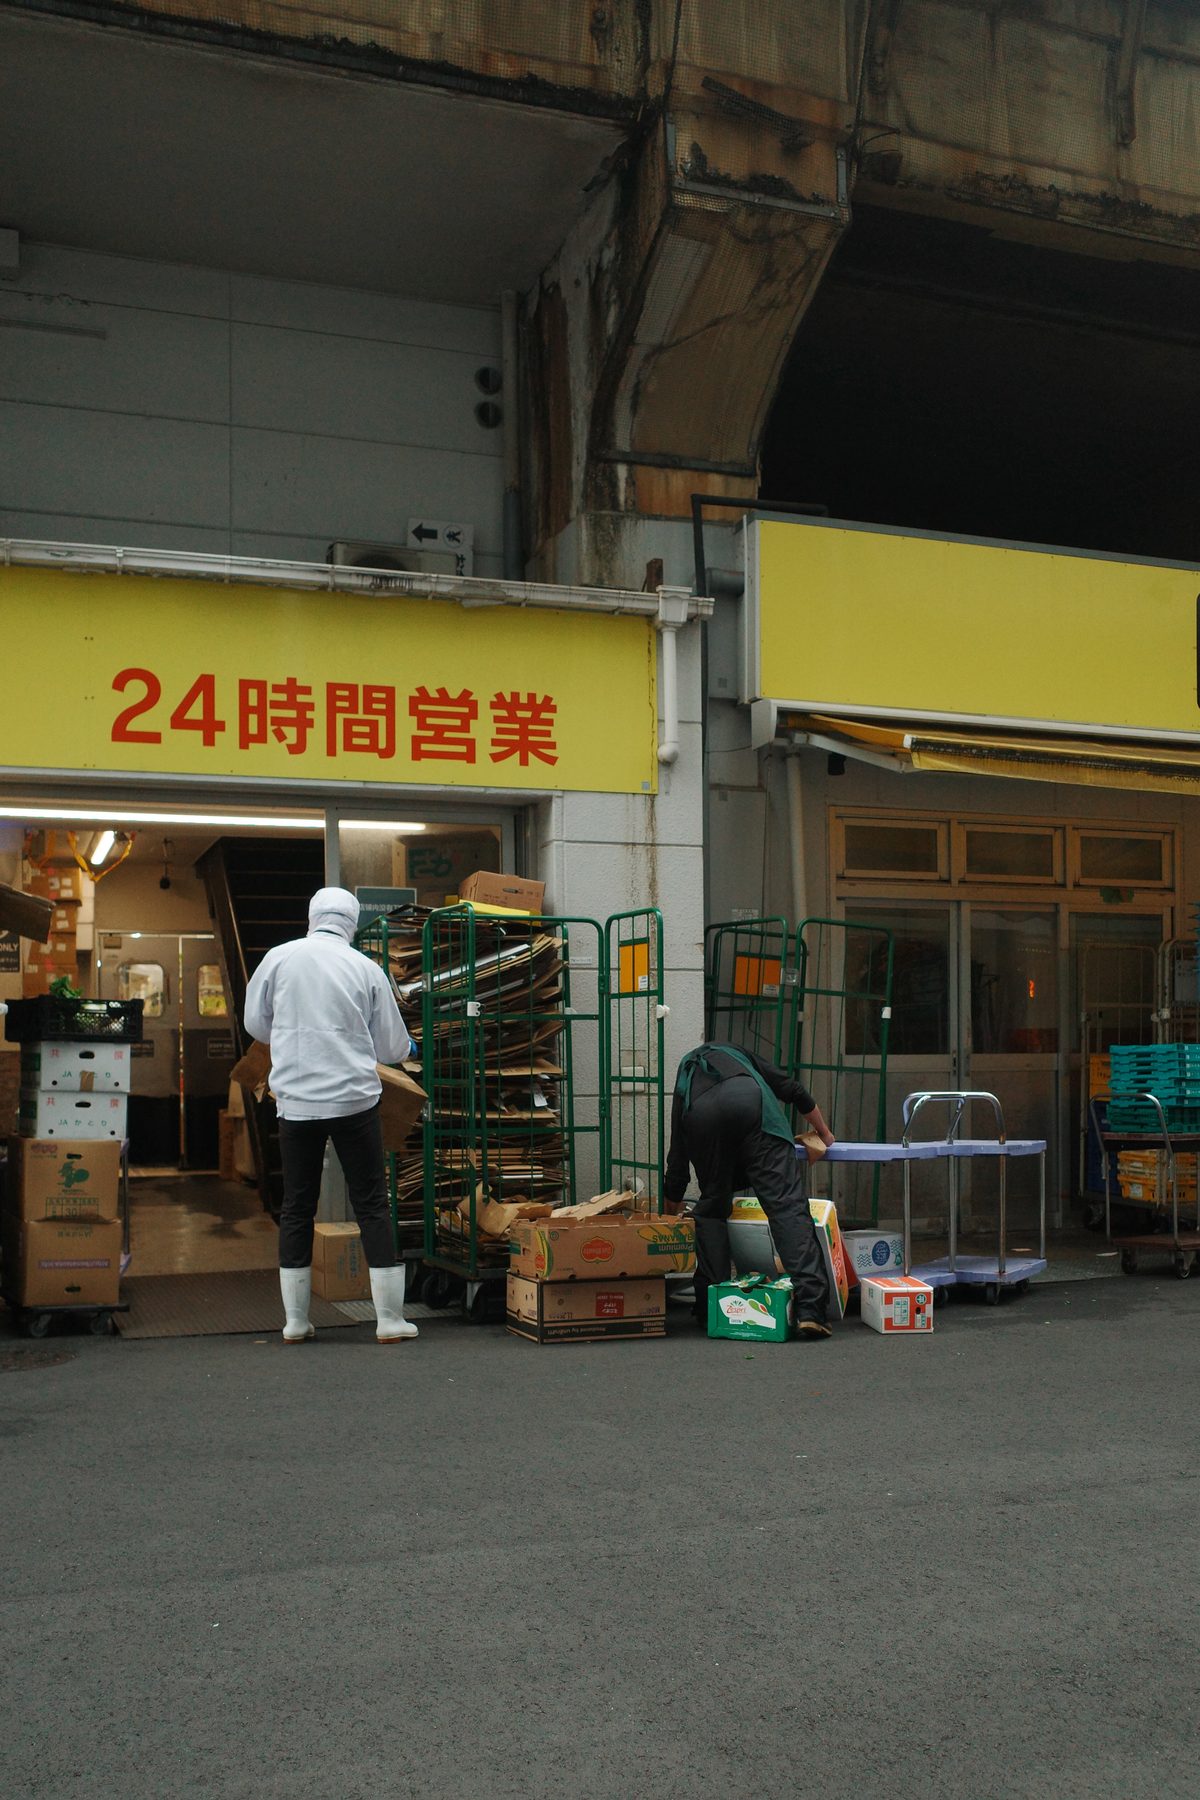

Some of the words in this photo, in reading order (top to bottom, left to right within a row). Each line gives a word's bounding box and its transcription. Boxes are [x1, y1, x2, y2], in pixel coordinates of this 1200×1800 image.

[110, 667, 559, 767] 24時間営業
[658, 1243, 694, 1252] Premium
